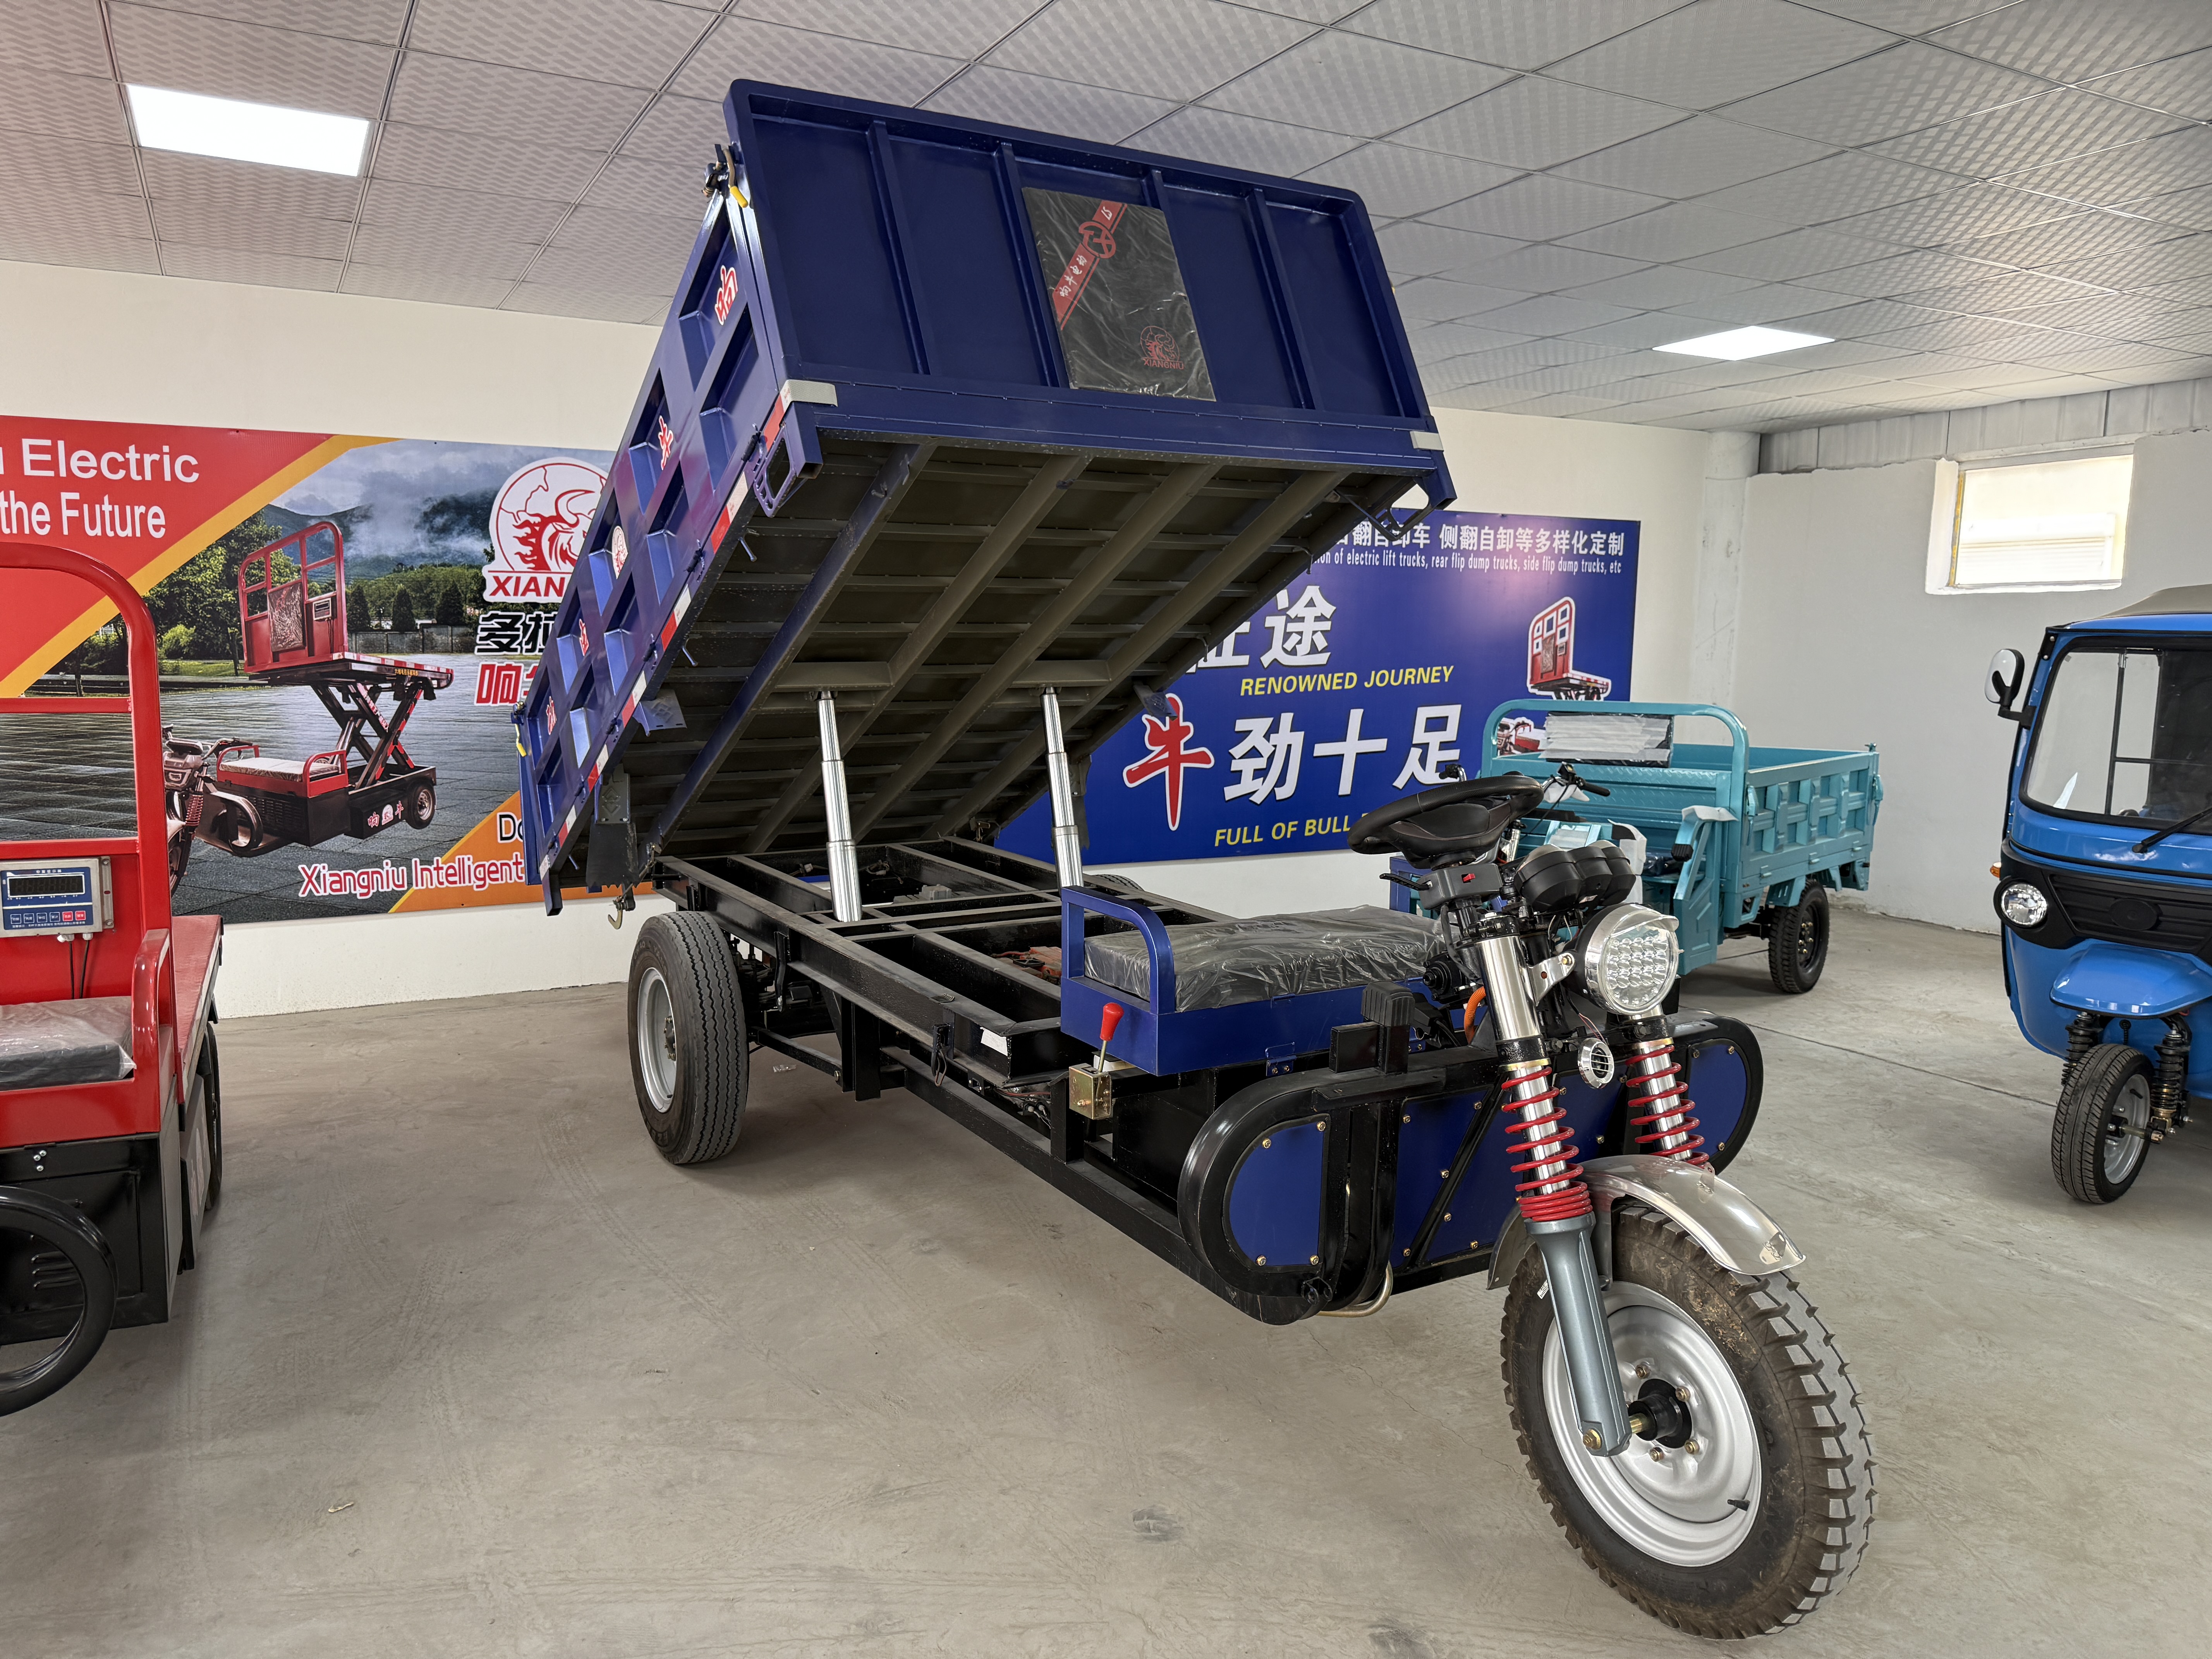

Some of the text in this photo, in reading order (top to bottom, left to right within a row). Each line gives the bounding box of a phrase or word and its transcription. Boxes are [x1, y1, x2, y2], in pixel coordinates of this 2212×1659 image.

[1144, 359, 1184, 369] XIANGNIU
[22, 438, 199, 483] Electric
[0, 490, 166, 538] the Future
[1439, 524, 1625, 556] 侧翻自卸等多样化定制
[1334, 548, 1343, 564] of
[1347, 549, 1379, 565] electric
[1383, 550, 1395, 566] lift
[1400, 551, 1428, 569] trucks,
[1432, 556, 1448, 568] rear
[1451, 553, 1465, 572] flip
[1468, 553, 1489, 573] dump
[1493, 555, 1520, 572] trucks,
[1523, 556, 1539, 571] side
[1542, 555, 1554, 574] flip
[1558, 556, 1578, 575] dump
[1582, 558, 1607, 575] trucks,
[1610, 560, 1621, 573] etc
[489, 576, 565, 597] XIAN
[476, 664, 538, 704] 响
[1240, 666, 1454, 696] RENOWNED JOURNEY
[1215, 816, 1350, 847] FULL OF BULL
[301, 853, 523, 897] Xiangniu Intelligent
